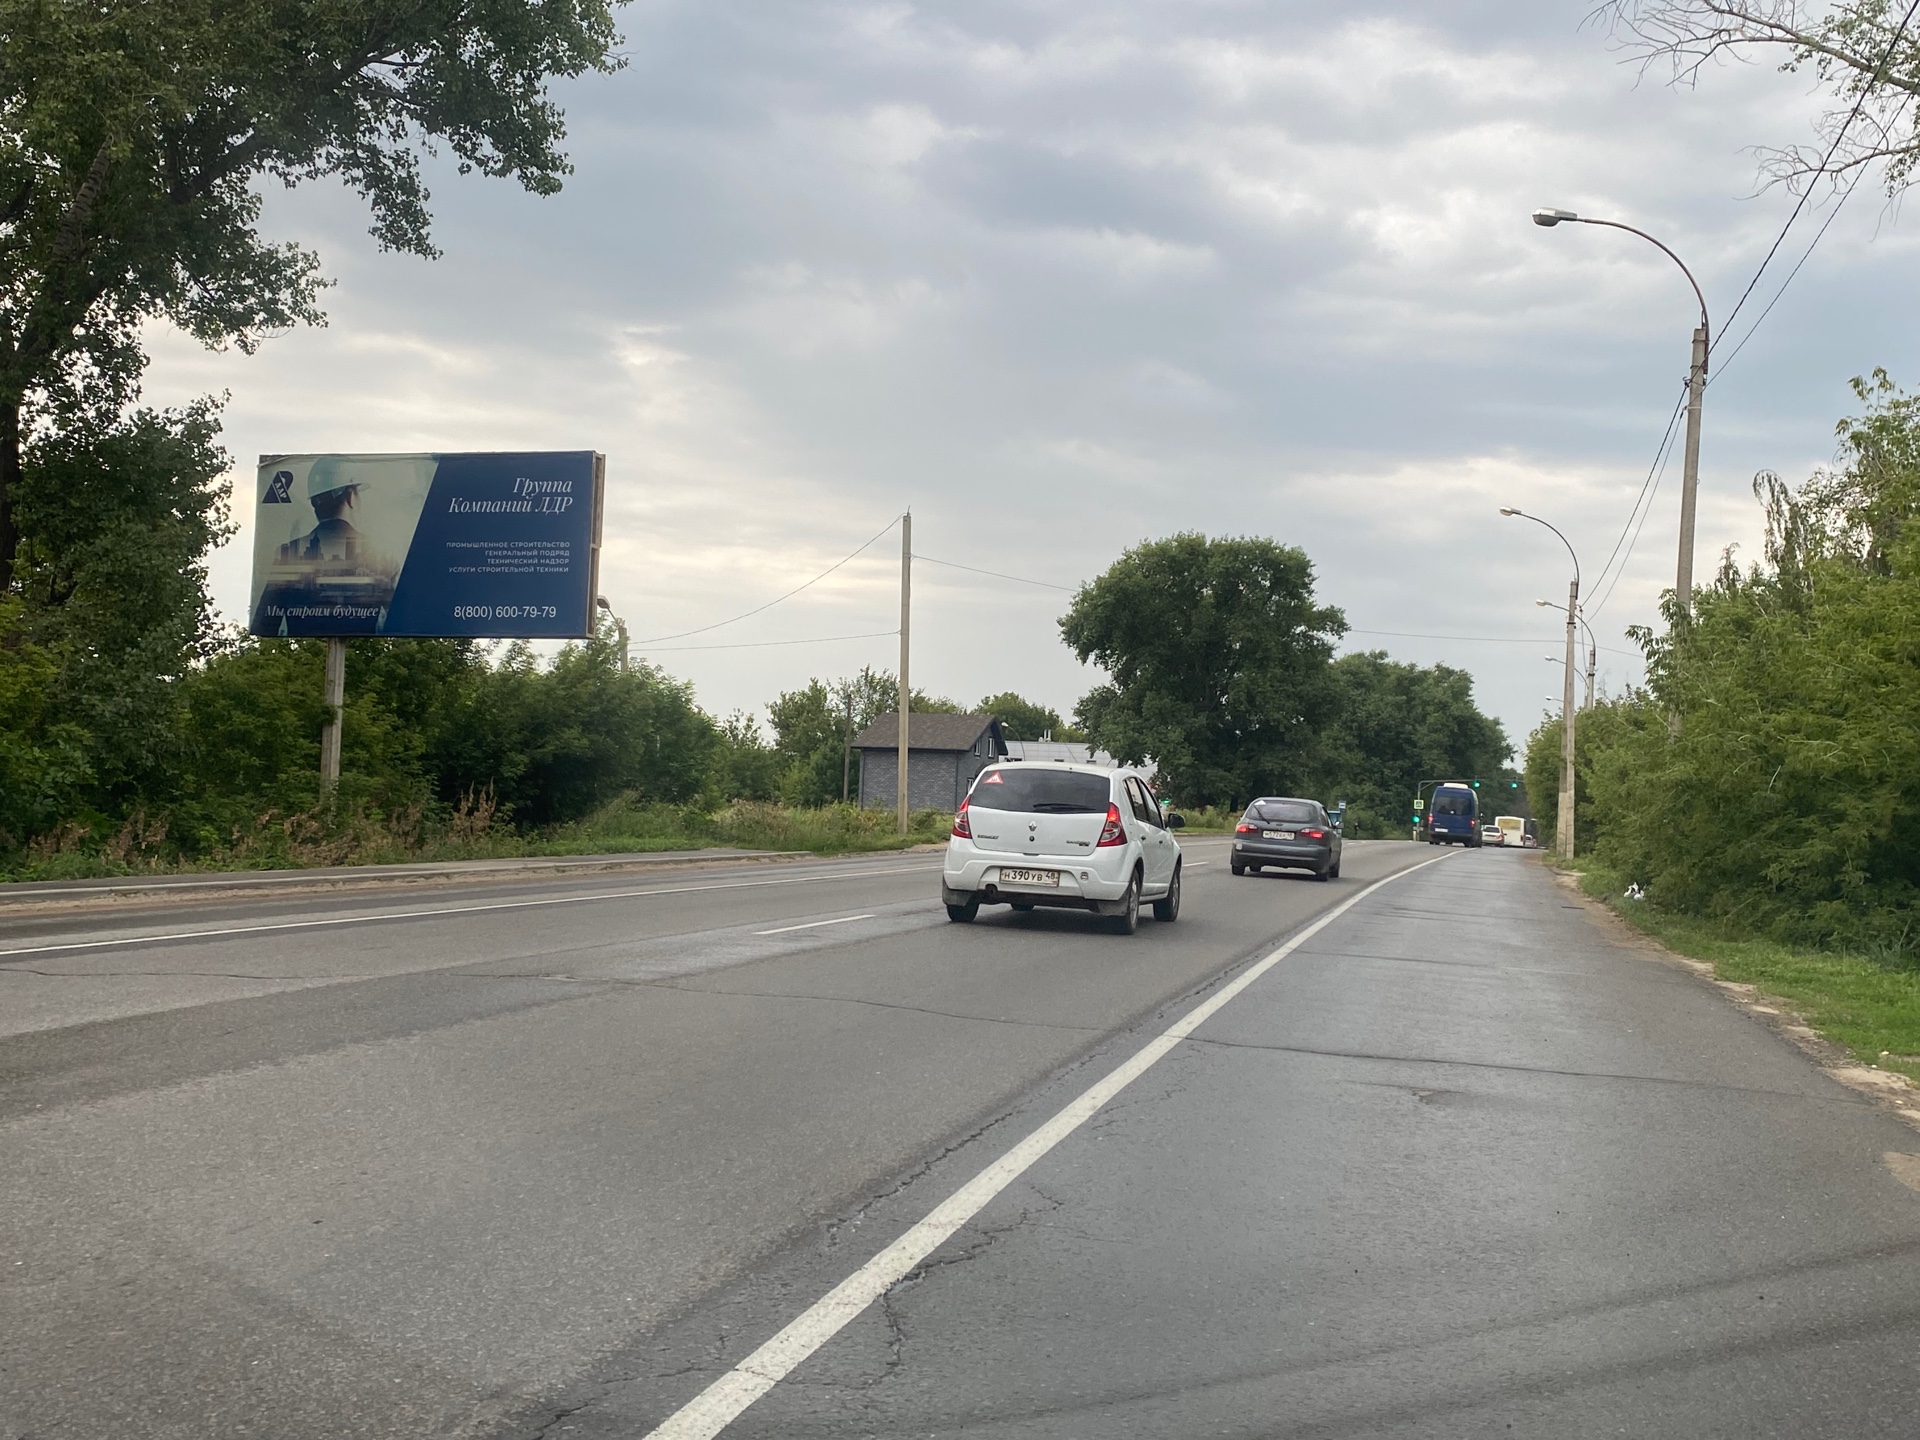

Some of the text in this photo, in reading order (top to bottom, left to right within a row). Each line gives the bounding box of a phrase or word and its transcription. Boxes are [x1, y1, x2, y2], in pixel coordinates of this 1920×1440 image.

[513, 477, 573, 497] Группа
[448, 495, 573, 515] Компаний ЛДР
[265, 604, 379, 619] Мы строим будущее
[453, 605, 557, 620] 8(800) 600-79-79
